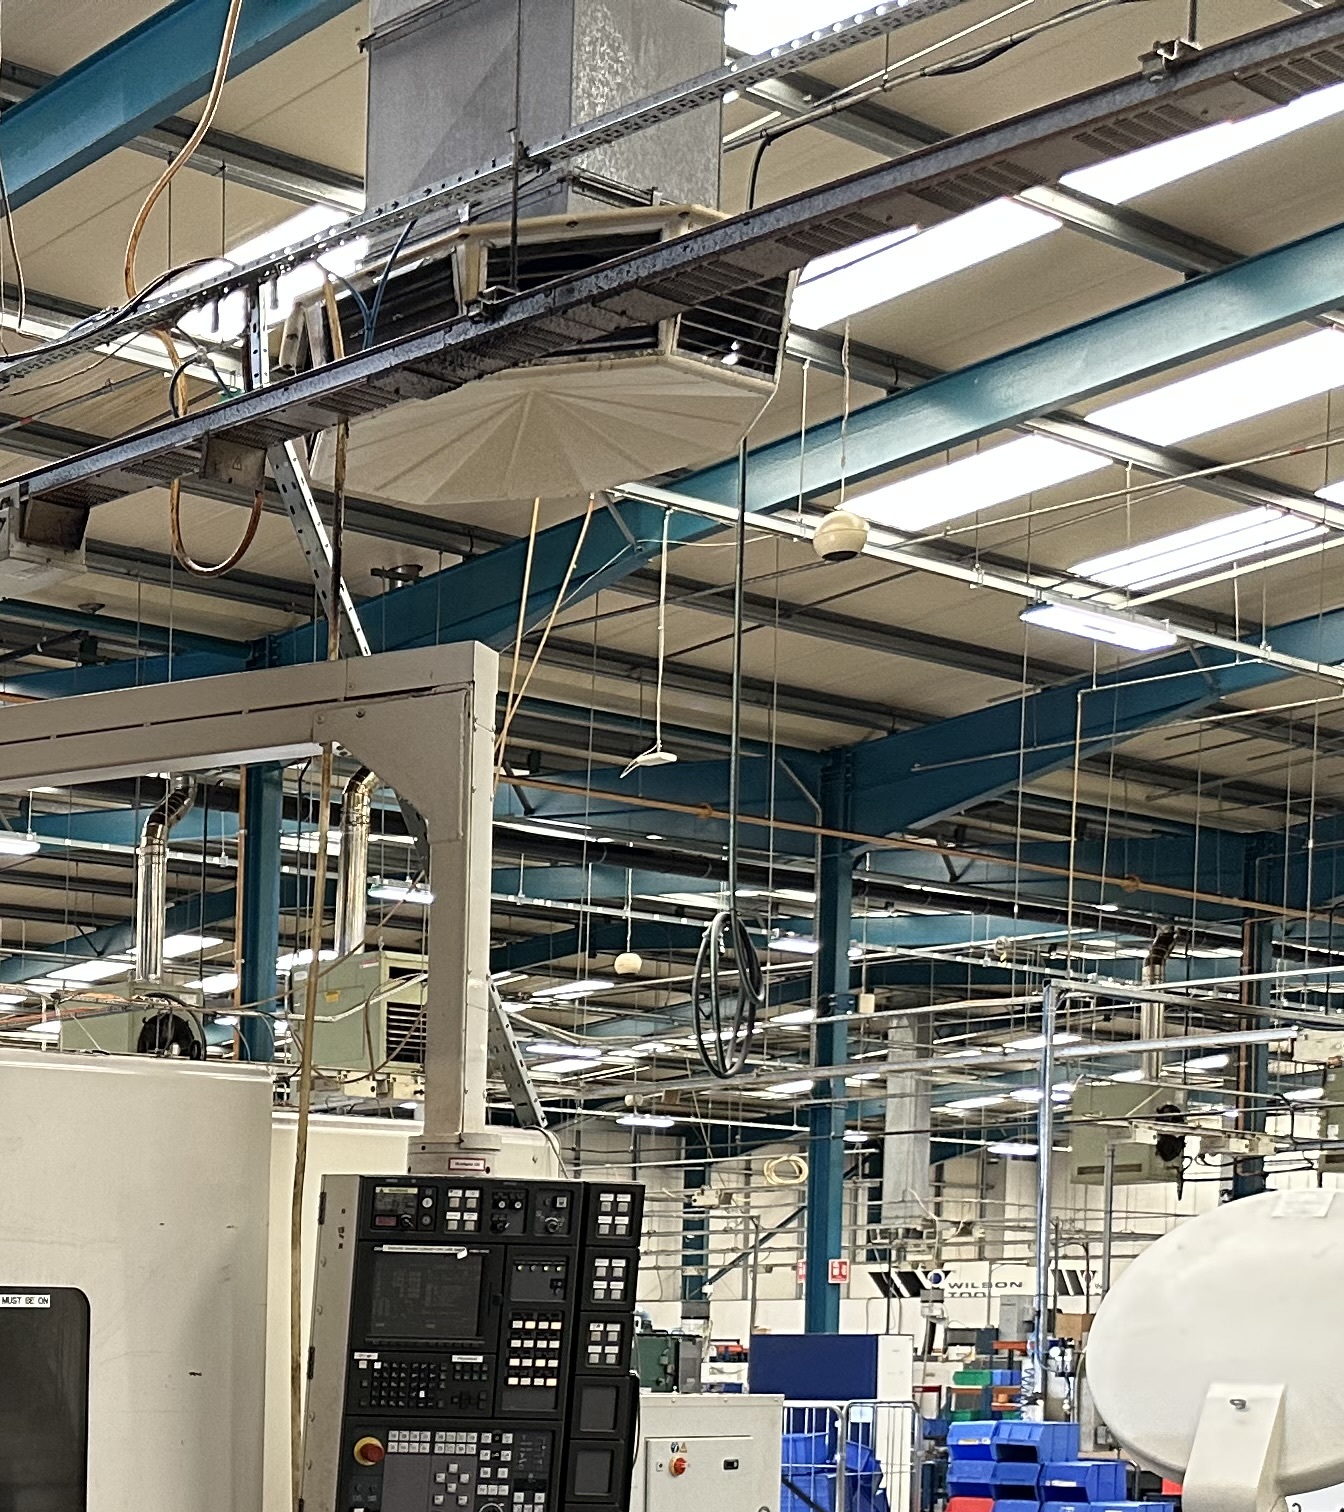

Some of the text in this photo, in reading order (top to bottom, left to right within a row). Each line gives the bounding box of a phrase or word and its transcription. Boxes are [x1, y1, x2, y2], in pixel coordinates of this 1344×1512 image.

[948, 1281, 1023, 1289] WILSON
[2, 1296, 22, 1305] MUST
[38, 1296, 49, 1305] ON
